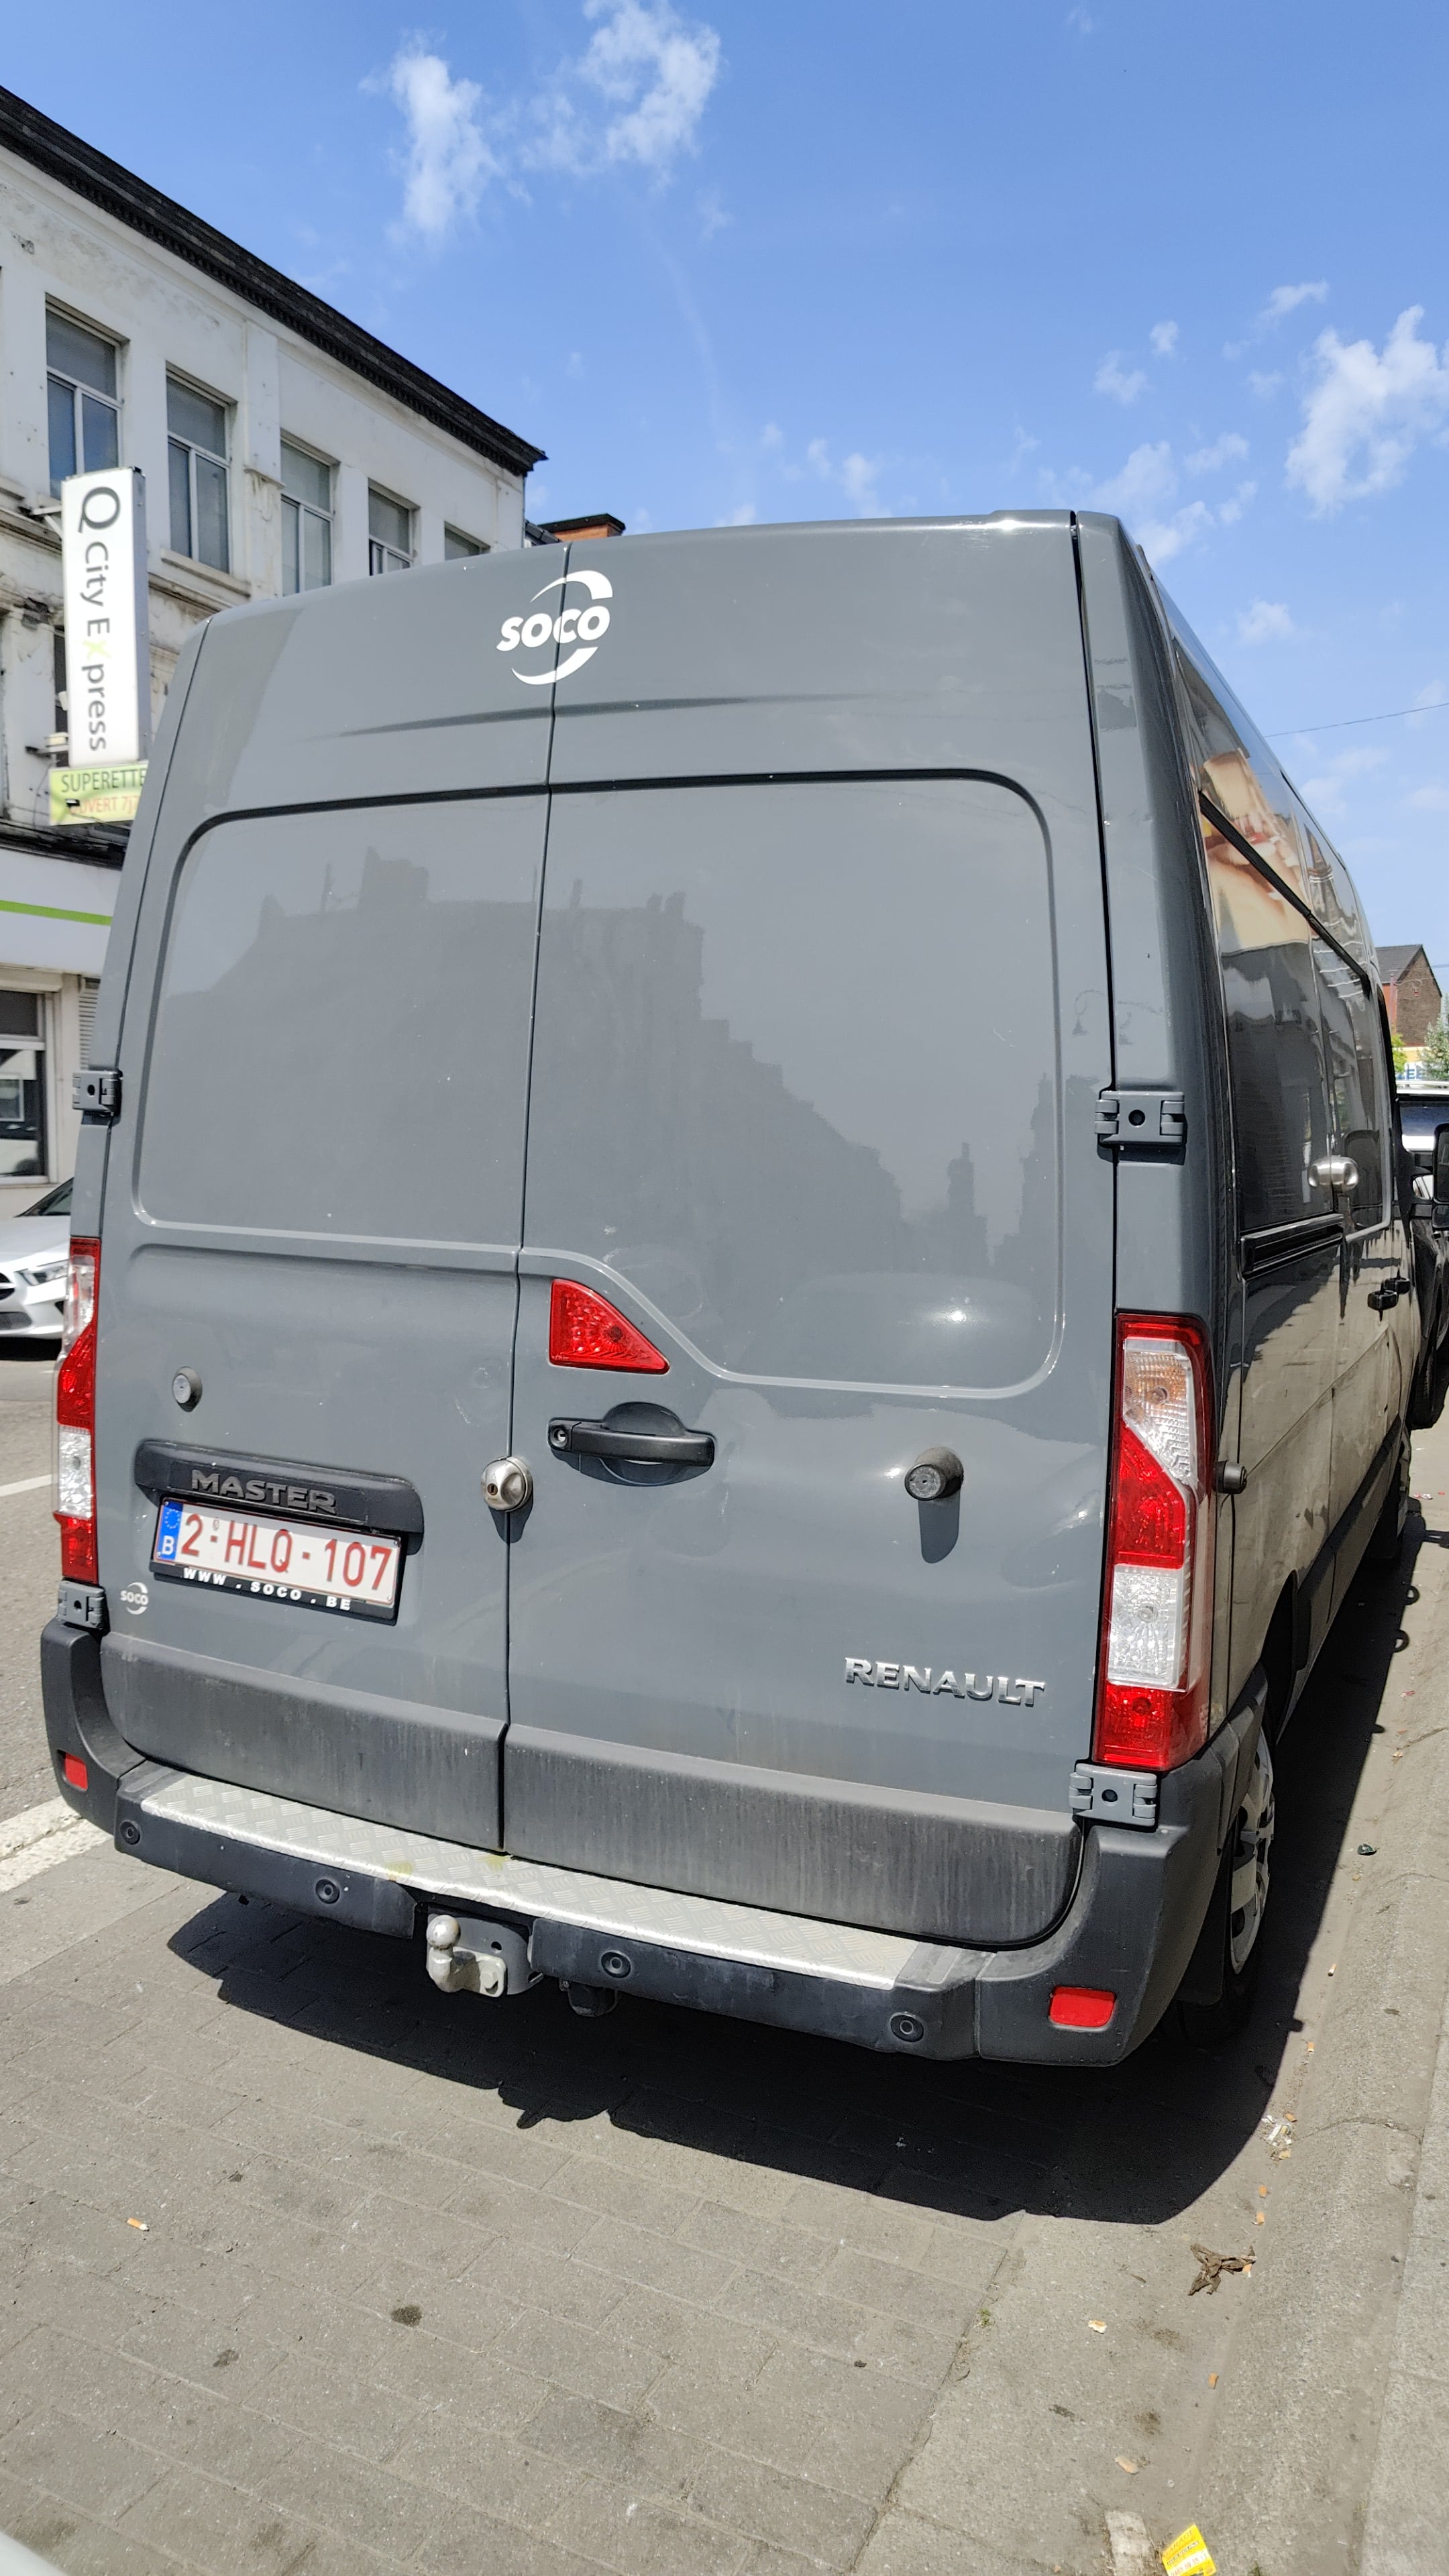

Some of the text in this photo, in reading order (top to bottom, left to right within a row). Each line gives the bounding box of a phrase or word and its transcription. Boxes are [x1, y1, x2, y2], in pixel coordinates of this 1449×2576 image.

[80, 541, 109, 606] City
[496, 605, 610, 651] SOCO
[61, 768, 148, 793] SUPERETTE
[70, 796, 118, 815] UVERT
[191, 1469, 336, 1513] MASTER
[162, 1537, 174, 1556] B
[120, 1590, 149, 1606] SOCO
[845, 1656, 1046, 1707] RENAULT
